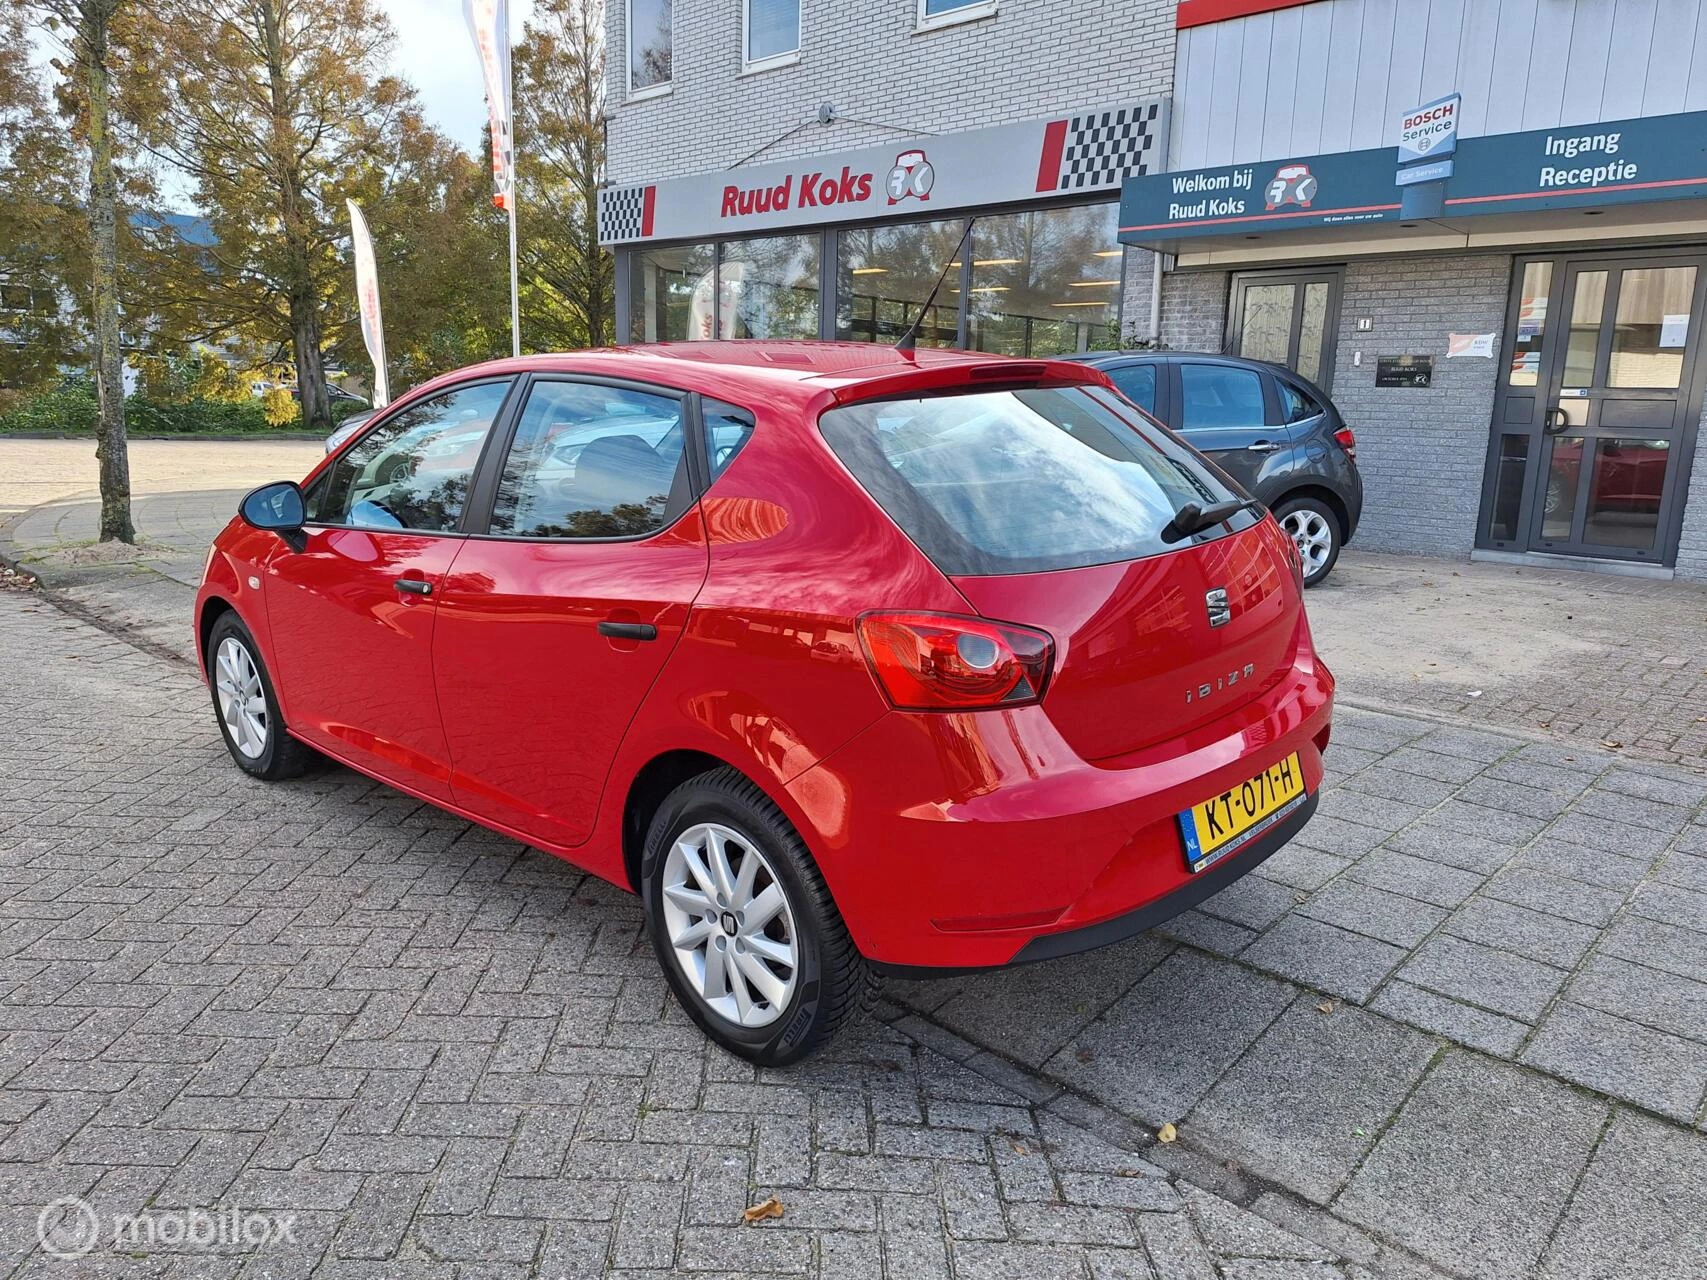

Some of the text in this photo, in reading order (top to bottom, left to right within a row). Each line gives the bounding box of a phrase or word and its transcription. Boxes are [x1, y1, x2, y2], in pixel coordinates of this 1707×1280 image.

[1404, 103, 1454, 130] BOSCH
[1402, 120, 1452, 142] Service
[1545, 133, 1621, 158] Ingang
[1172, 169, 1253, 194] Welkom bij
[1540, 159, 1638, 187] Receptie
[721, 166, 873, 217] Ruud Koks
[1168, 197, 1245, 220] Ruud Koks
[1203, 757, 1295, 841] KT-071-H
[1186, 838, 1199, 851] NL
